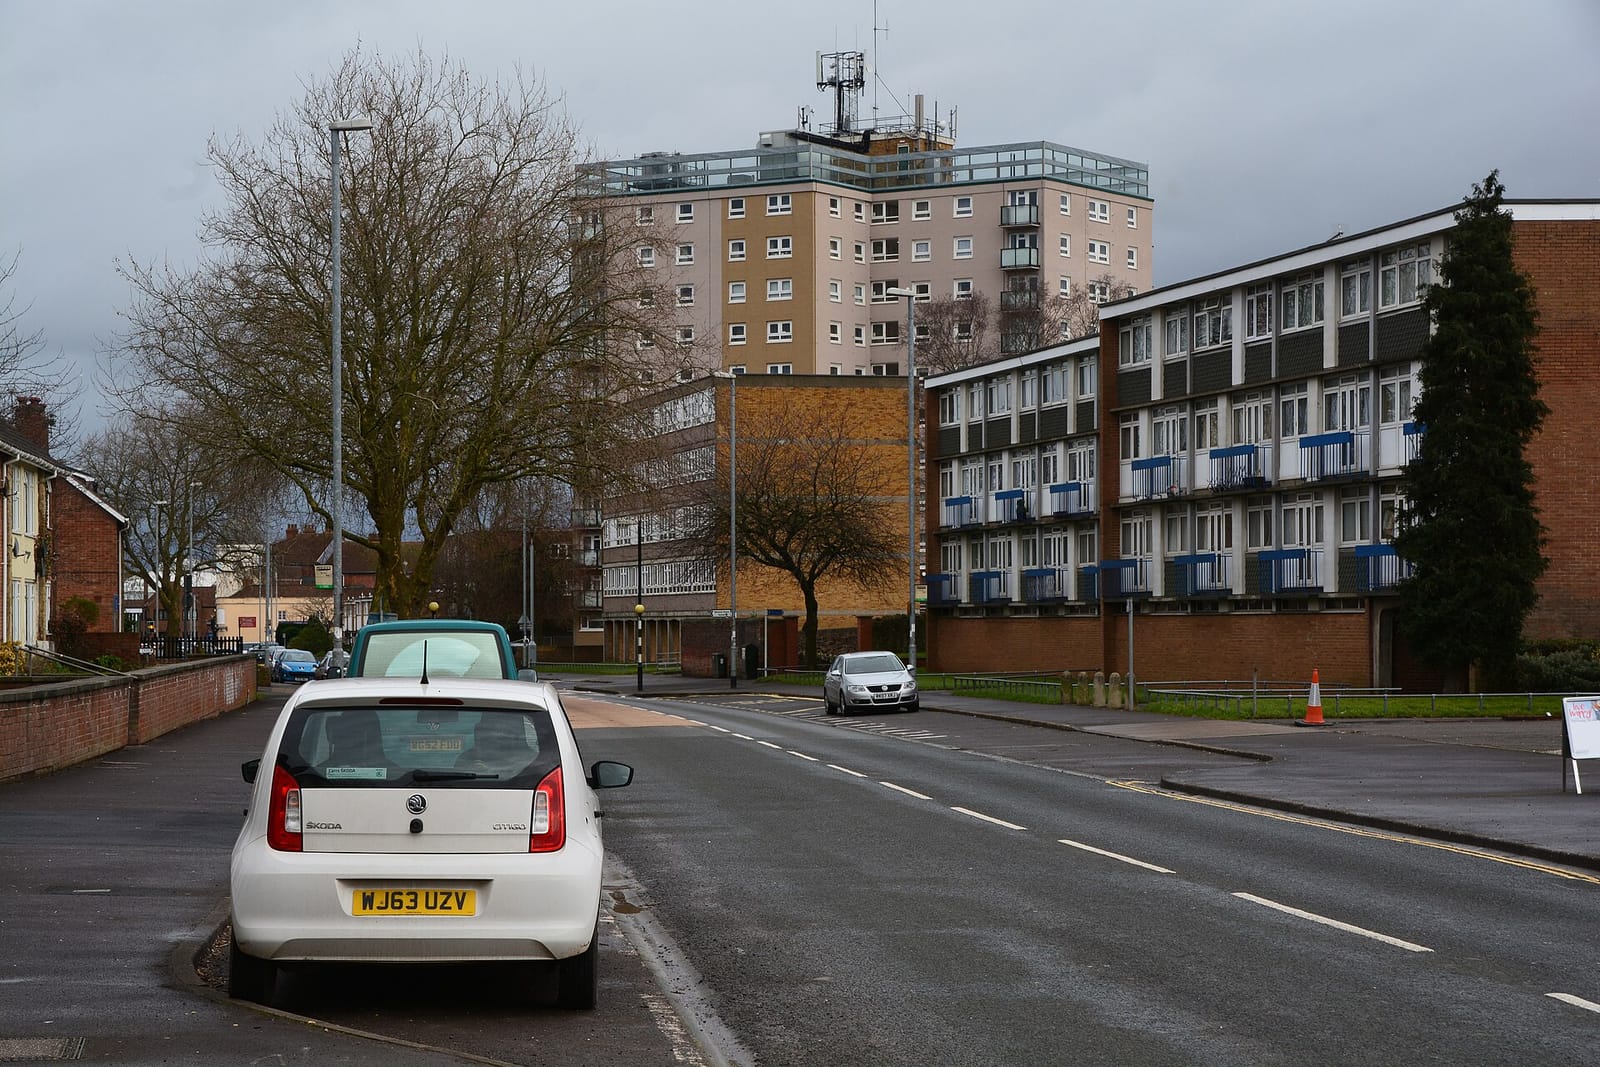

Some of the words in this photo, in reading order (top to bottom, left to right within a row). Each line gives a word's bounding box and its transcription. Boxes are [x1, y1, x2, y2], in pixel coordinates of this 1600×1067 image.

[306, 821, 342, 830] ŠKODA
[362, 891, 418, 911] WJ63
[425, 891, 467, 911] UZV
